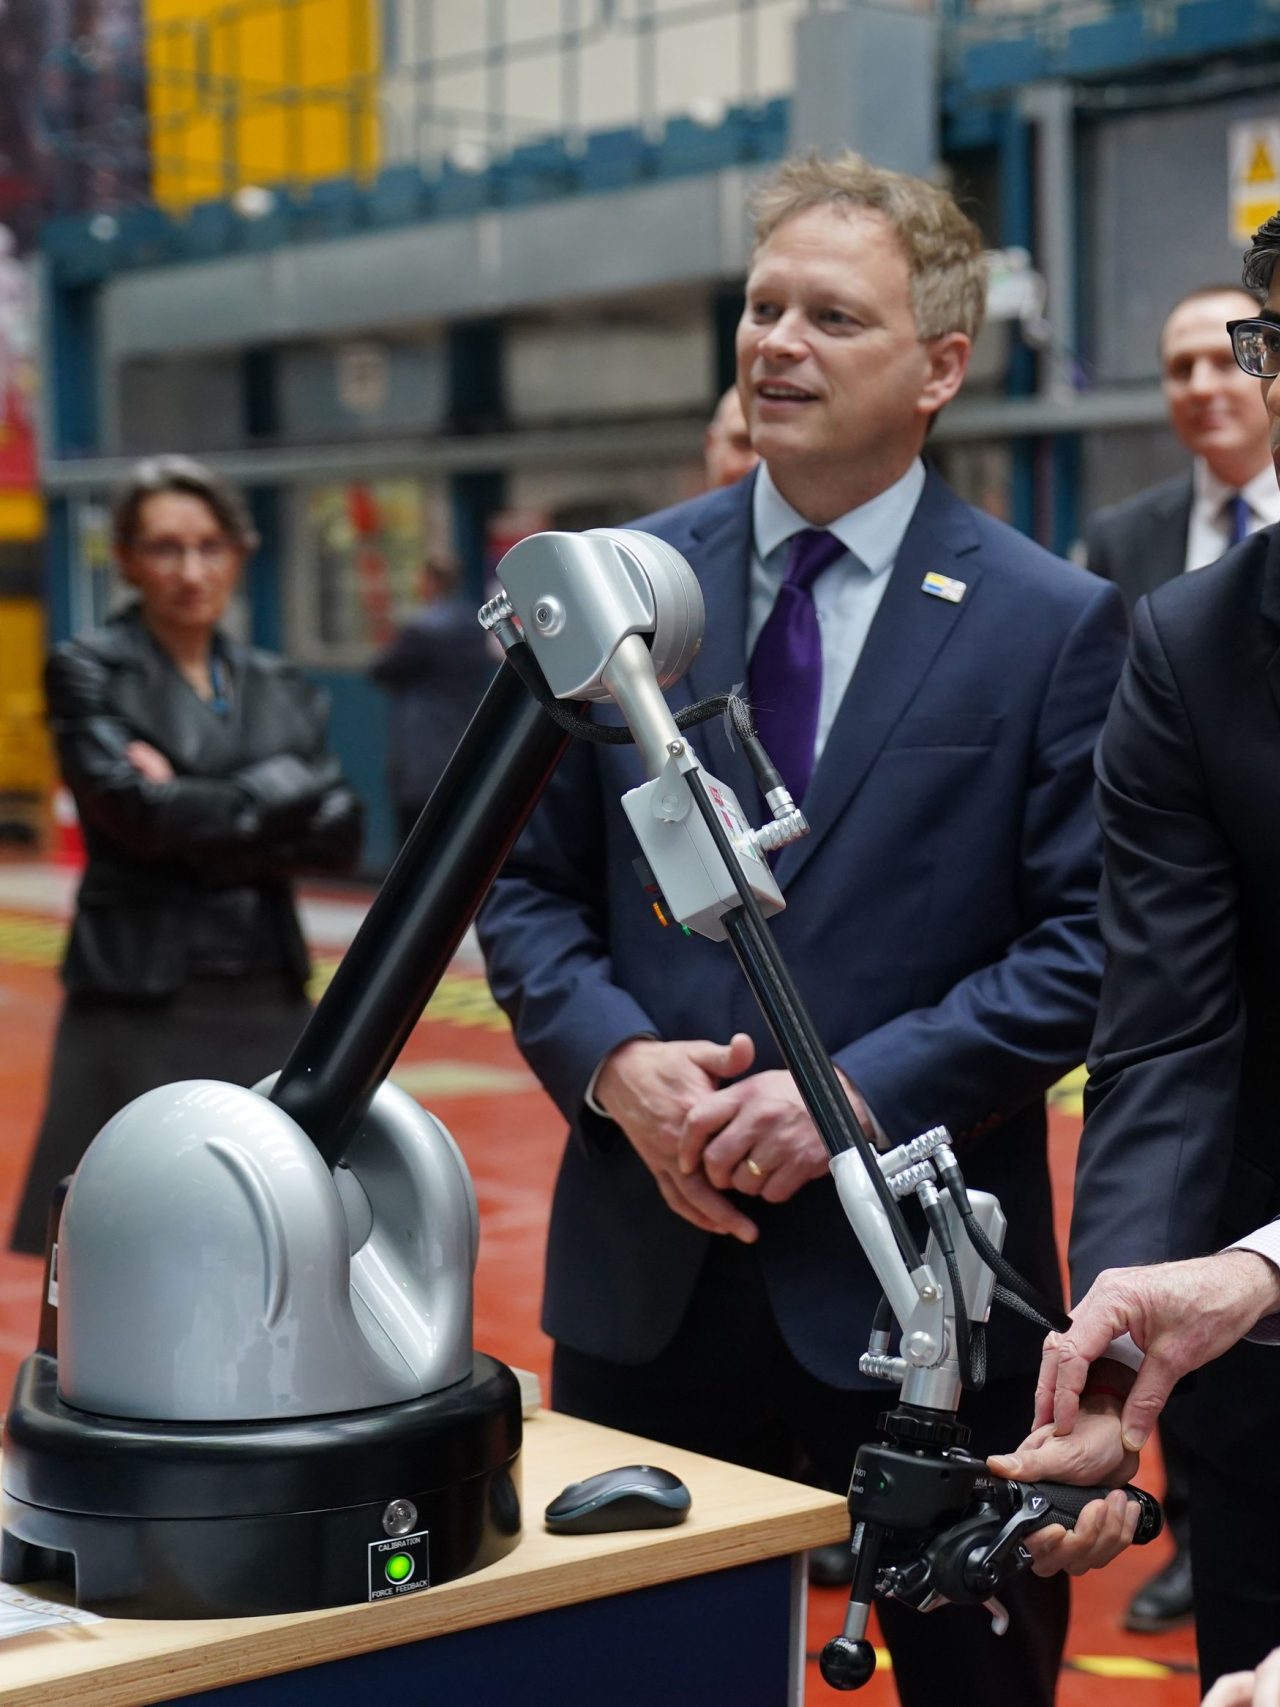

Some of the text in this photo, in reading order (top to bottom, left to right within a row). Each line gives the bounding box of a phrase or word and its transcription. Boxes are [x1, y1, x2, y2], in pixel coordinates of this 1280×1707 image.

[378, 1537, 421, 1552] CALIBRATION
[372, 1580, 428, 1598] FORCE FEEDBACK
